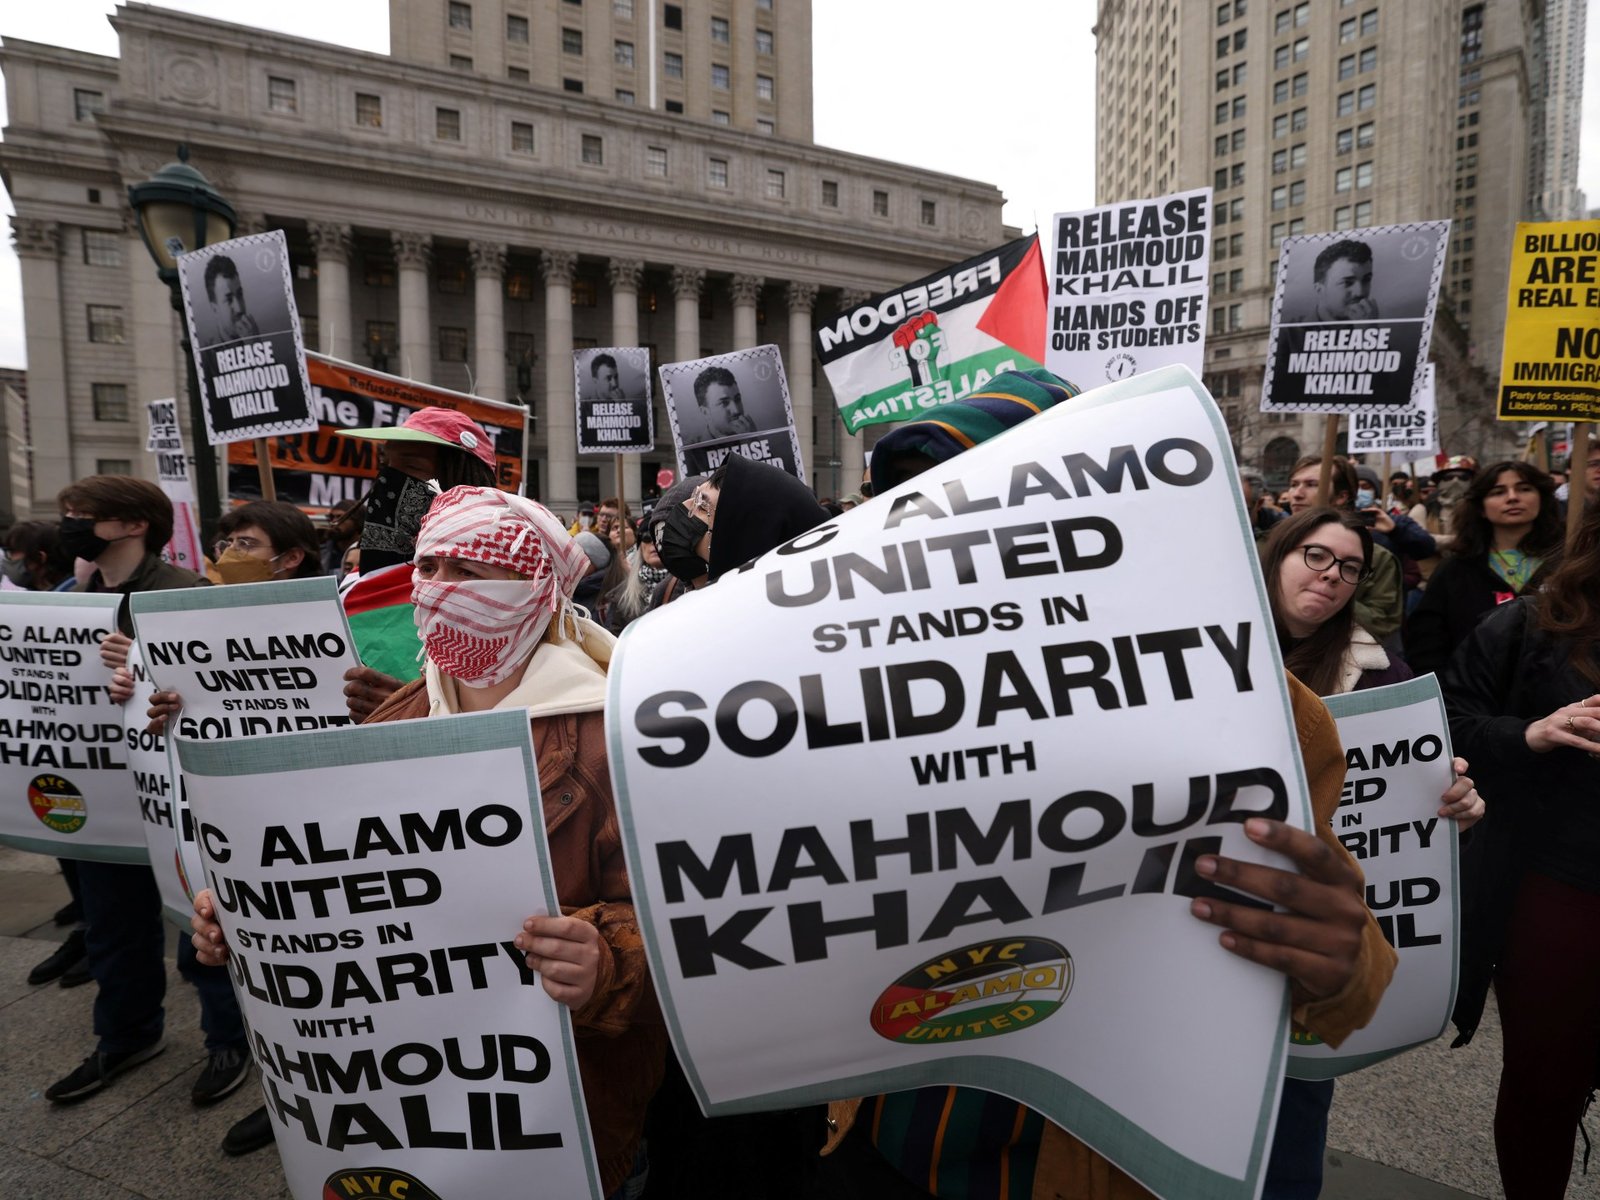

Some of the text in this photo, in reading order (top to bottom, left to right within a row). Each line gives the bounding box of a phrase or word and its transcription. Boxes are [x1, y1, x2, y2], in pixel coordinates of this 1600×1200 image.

[466, 205, 821, 266] UNITED STATES COURT HOUSE
[1058, 195, 1207, 249] RELEASE
[1056, 234, 1205, 276] MAHMOUD
[1525, 232, 1600, 253] BILLIO
[1055, 264, 1204, 296] KHALIL
[1526, 256, 1597, 284] ARE
[1518, 288, 1578, 308] REAL
[1053, 294, 1204, 331] HANDS OFF
[1052, 323, 1201, 351] OUR STUDENTS
[1303, 328, 1391, 351] RELEASE
[216, 341, 275, 374] RELEASE
[1287, 351, 1402, 373] MAHMOUD
[212, 363, 290, 399] MAHMOUD
[1304, 374, 1374, 395] KHALIL
[229, 390, 280, 419] KHALIL
[312, 385, 359, 427] he
[592, 402, 634, 416] RELEASE
[1508, 402, 1557, 411] Liberation
[1510, 391, 1536, 402] Party
[1537, 391, 1551, 400] for
[586, 415, 641, 429] MAHMOUD
[1356, 410, 1426, 430] HANDS
[1356, 428, 1425, 440] OFF
[597, 428, 632, 441] KHALIL
[1354, 438, 1425, 449] OUR STUDENTS
[884, 437, 1213, 529] ALAMO
[765, 516, 1123, 608] UNITED
[813, 594, 1089, 653] STANDS IN
[0, 646, 82, 667] UNITED
[147, 632, 346, 666] NYC ALAMO
[12, 667, 69, 681] STANDS IN
[195, 666, 318, 692] UNITED
[222, 697, 310, 711] STANDS IN
[635, 622, 1253, 768] SOLIDARITY
[31, 705, 56, 716] WITH
[0, 718, 124, 743] AHMOUD
[0, 742, 127, 770] HALIL
[911, 741, 1036, 786] WITH
[36, 776, 65, 789] NYC
[1342, 812, 1362, 828] IN
[260, 803, 523, 868] ALAMO
[655, 767, 1289, 904] MAHMOUD
[211, 867, 443, 921] UNITED
[669, 836, 1275, 979] KHALIL
[236, 922, 414, 954] STANDS IN
[925, 943, 1026, 980] NYC
[890, 966, 1057, 1020] ALAMO
[293, 1015, 375, 1038] WITH
[905, 1004, 1036, 1040] UNITED
[246, 1018, 551, 1095] AHMOUD
[262, 1075, 563, 1152] HALIL
[341, 1175, 409, 1200] NYC
